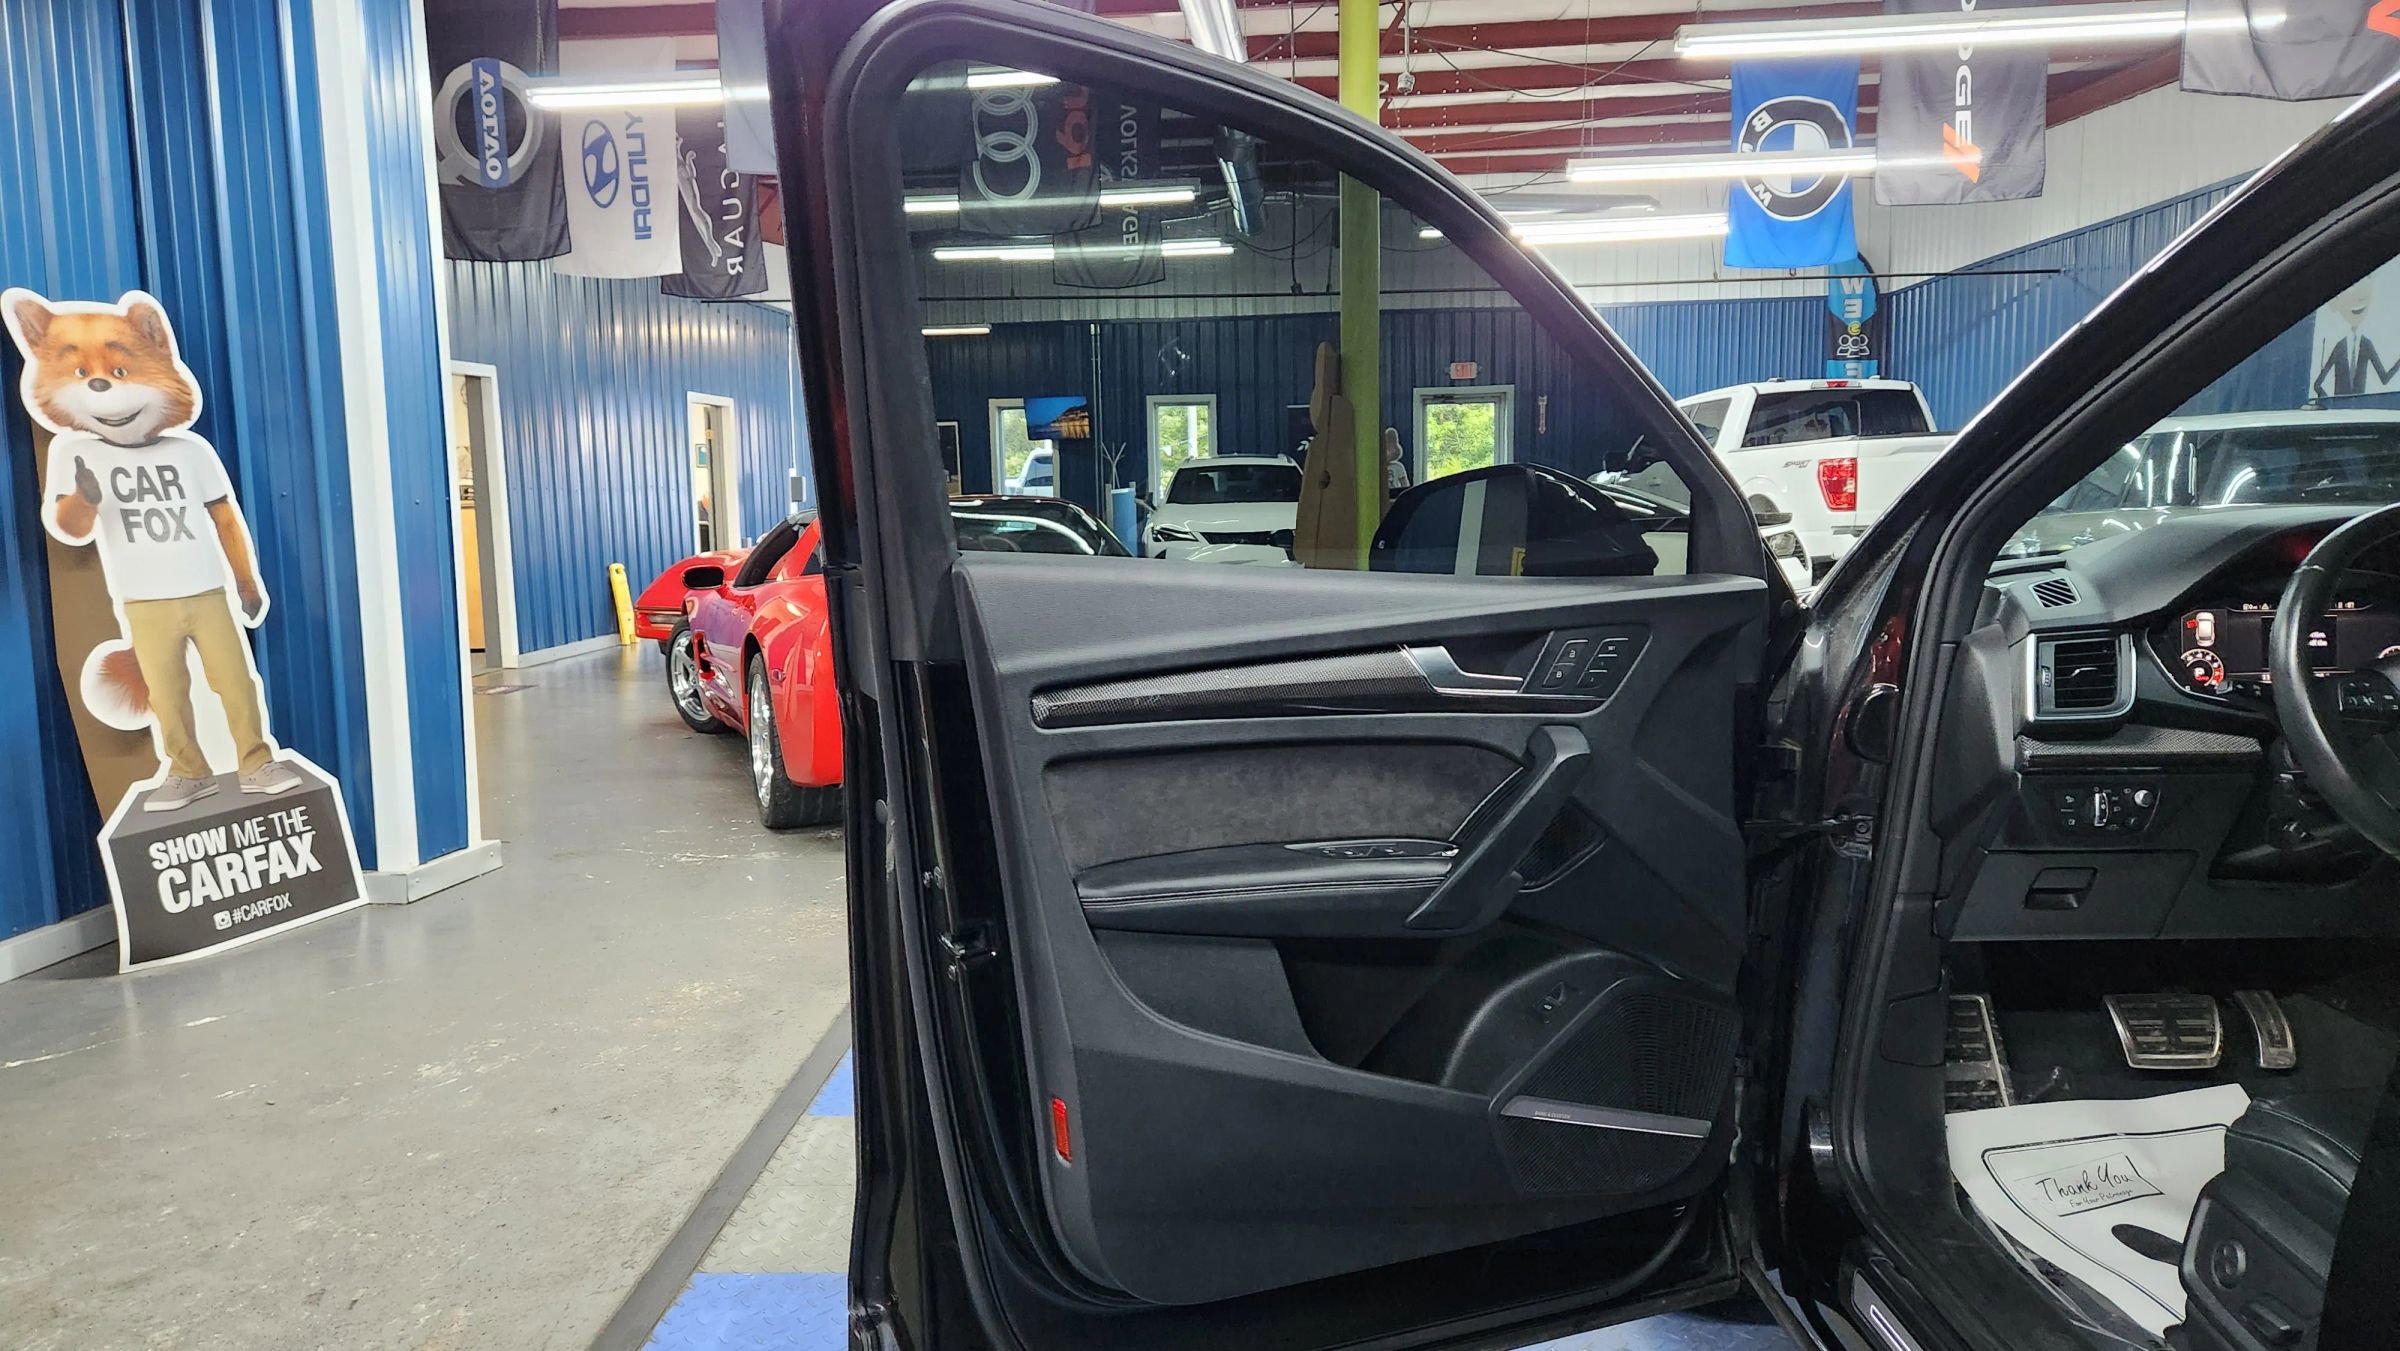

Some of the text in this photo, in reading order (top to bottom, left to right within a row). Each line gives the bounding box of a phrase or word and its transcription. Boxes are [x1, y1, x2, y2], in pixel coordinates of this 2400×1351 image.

[110, 464, 186, 503] CAR
[120, 506, 196, 543] FOX
[149, 806, 312, 870] SHOW ME THE
[157, 831, 323, 914] CARFAX
[232, 892, 292, 924] #CARFOX
[2035, 1169, 2098, 1201] Thank
